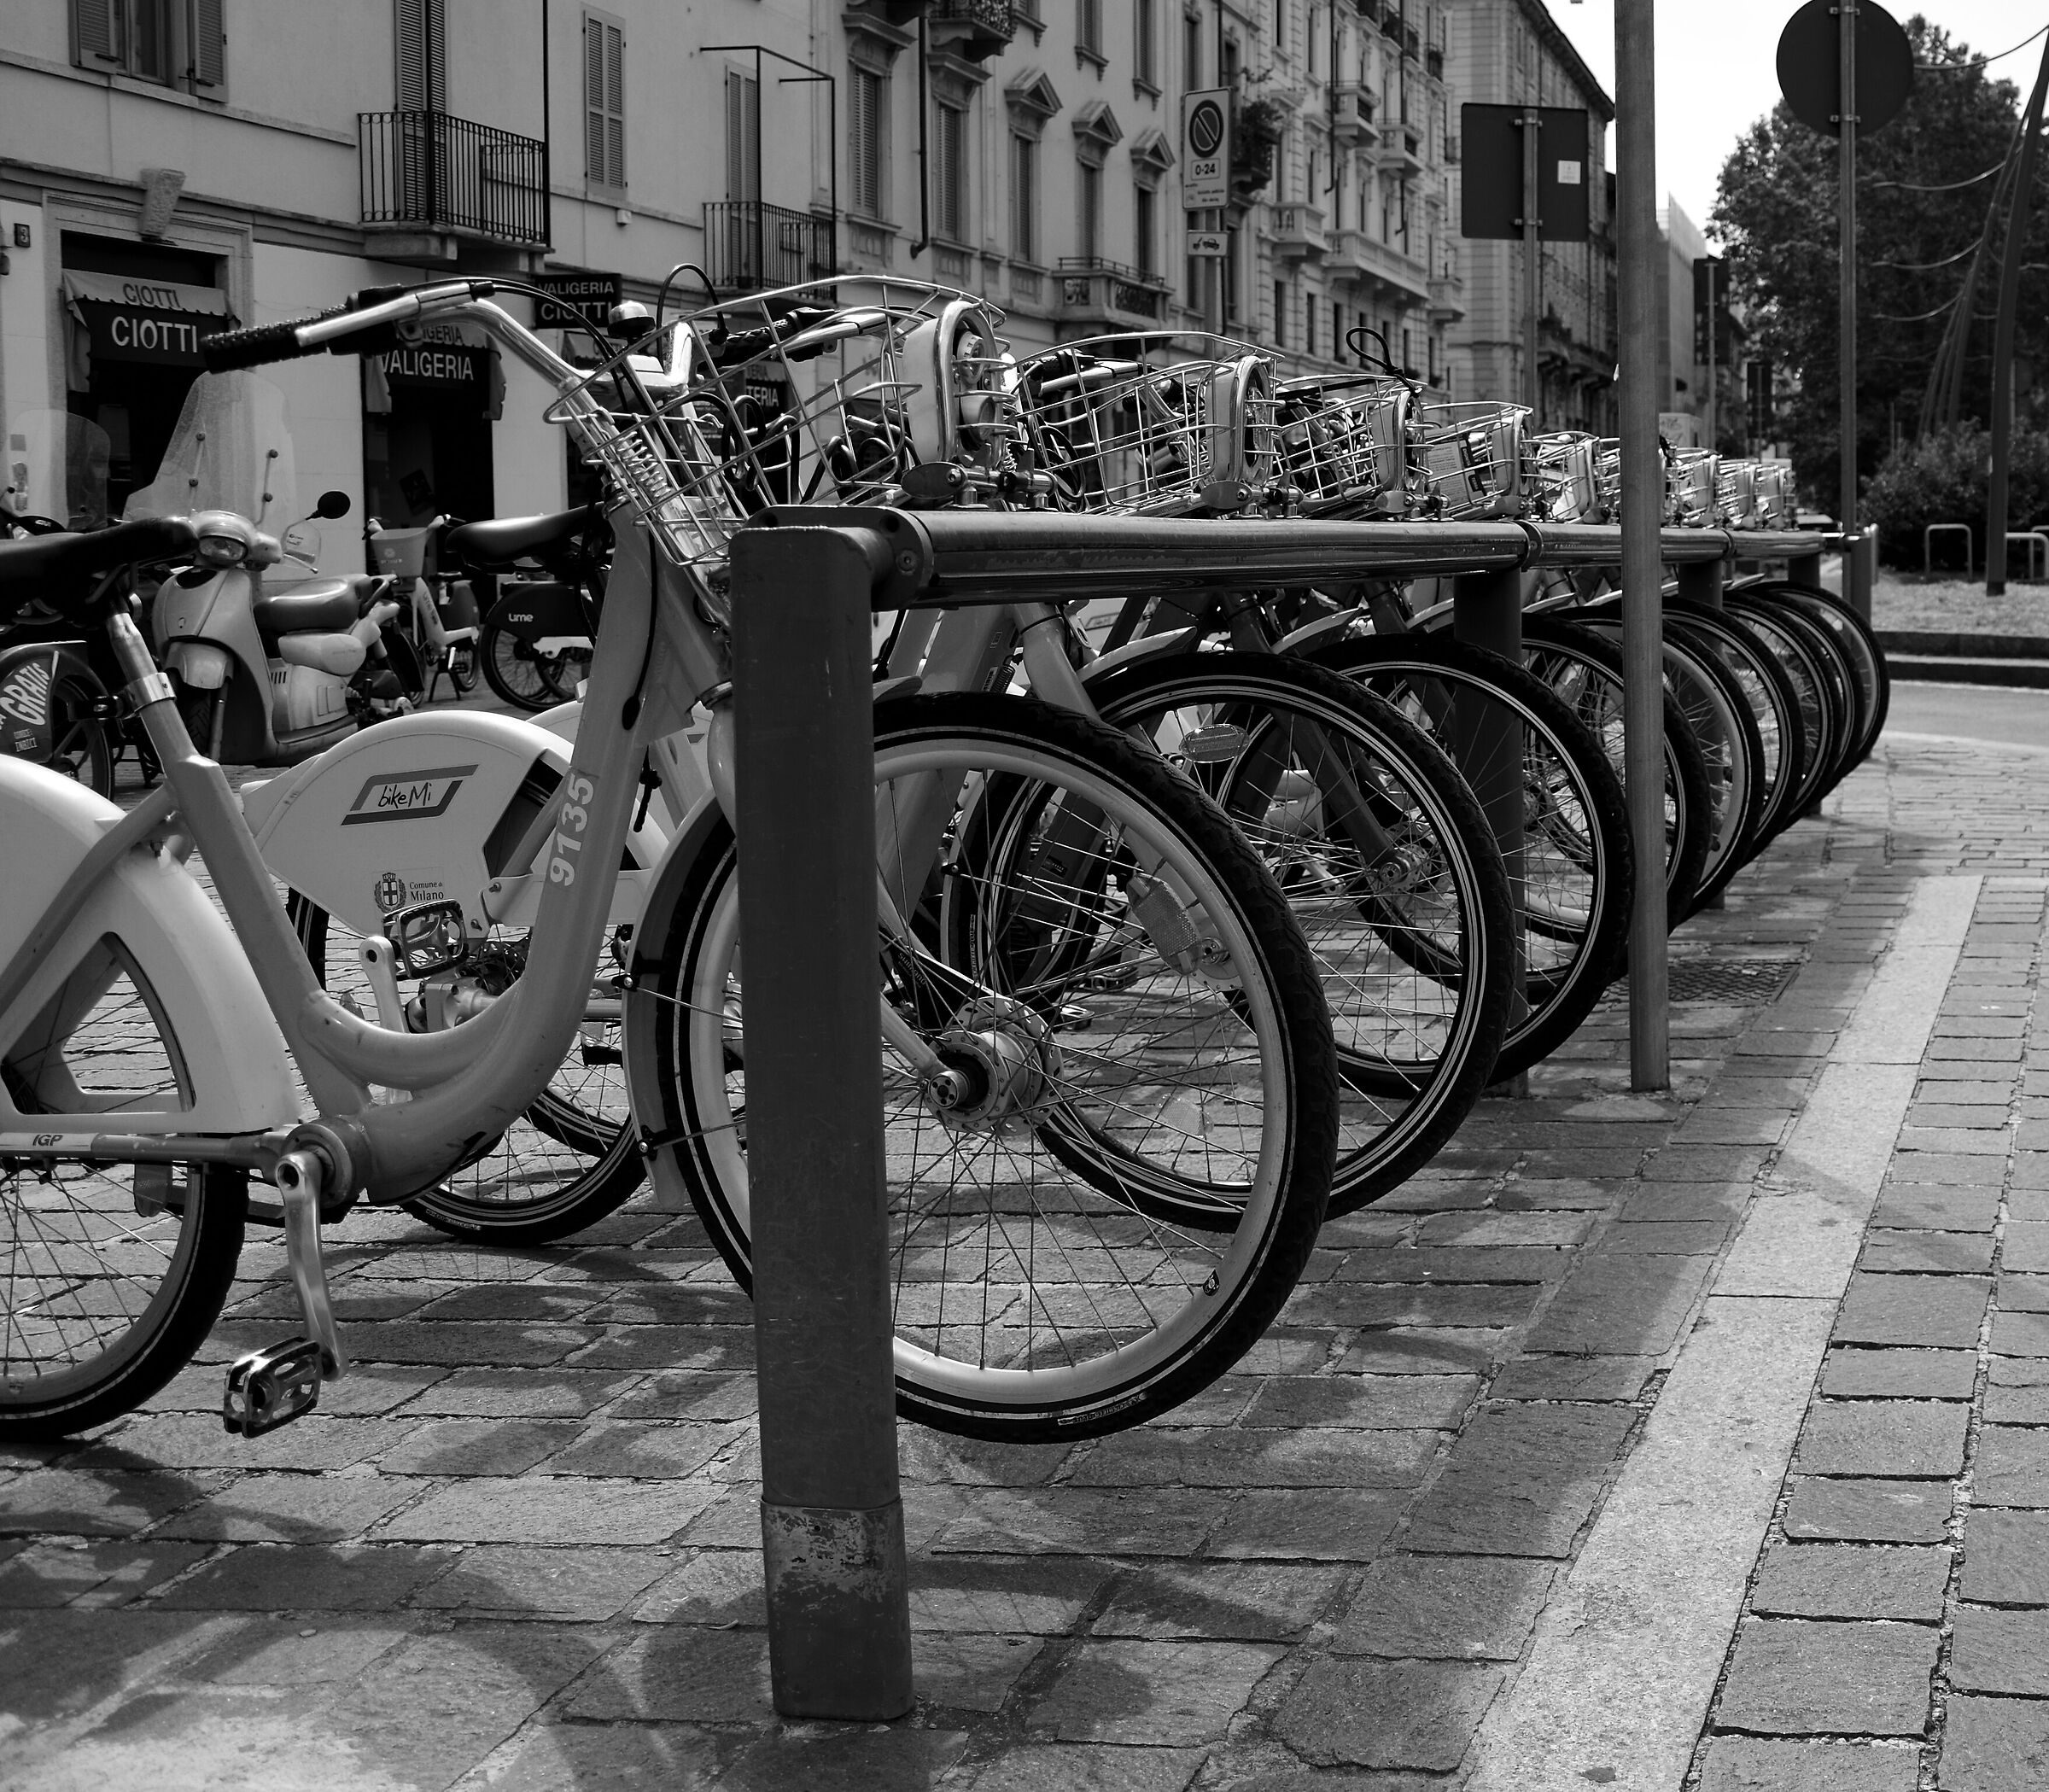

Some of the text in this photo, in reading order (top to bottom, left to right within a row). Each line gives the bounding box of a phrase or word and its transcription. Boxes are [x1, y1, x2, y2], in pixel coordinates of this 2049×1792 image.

[1195, 163, 1216, 175] 0-24
[123, 283, 181, 308] CIOTTI
[538, 281, 615, 295] VALIGERIA
[111, 316, 198, 353] CIOTTI
[423, 325, 464, 342] IGERIA
[382, 349, 474, 381] VALIGERIA
[0, 663, 50, 725] GRATIS
[550, 773, 593, 887] 9135
[410, 890, 444, 901] Milano
[32, 1134, 63, 1147] IGP
